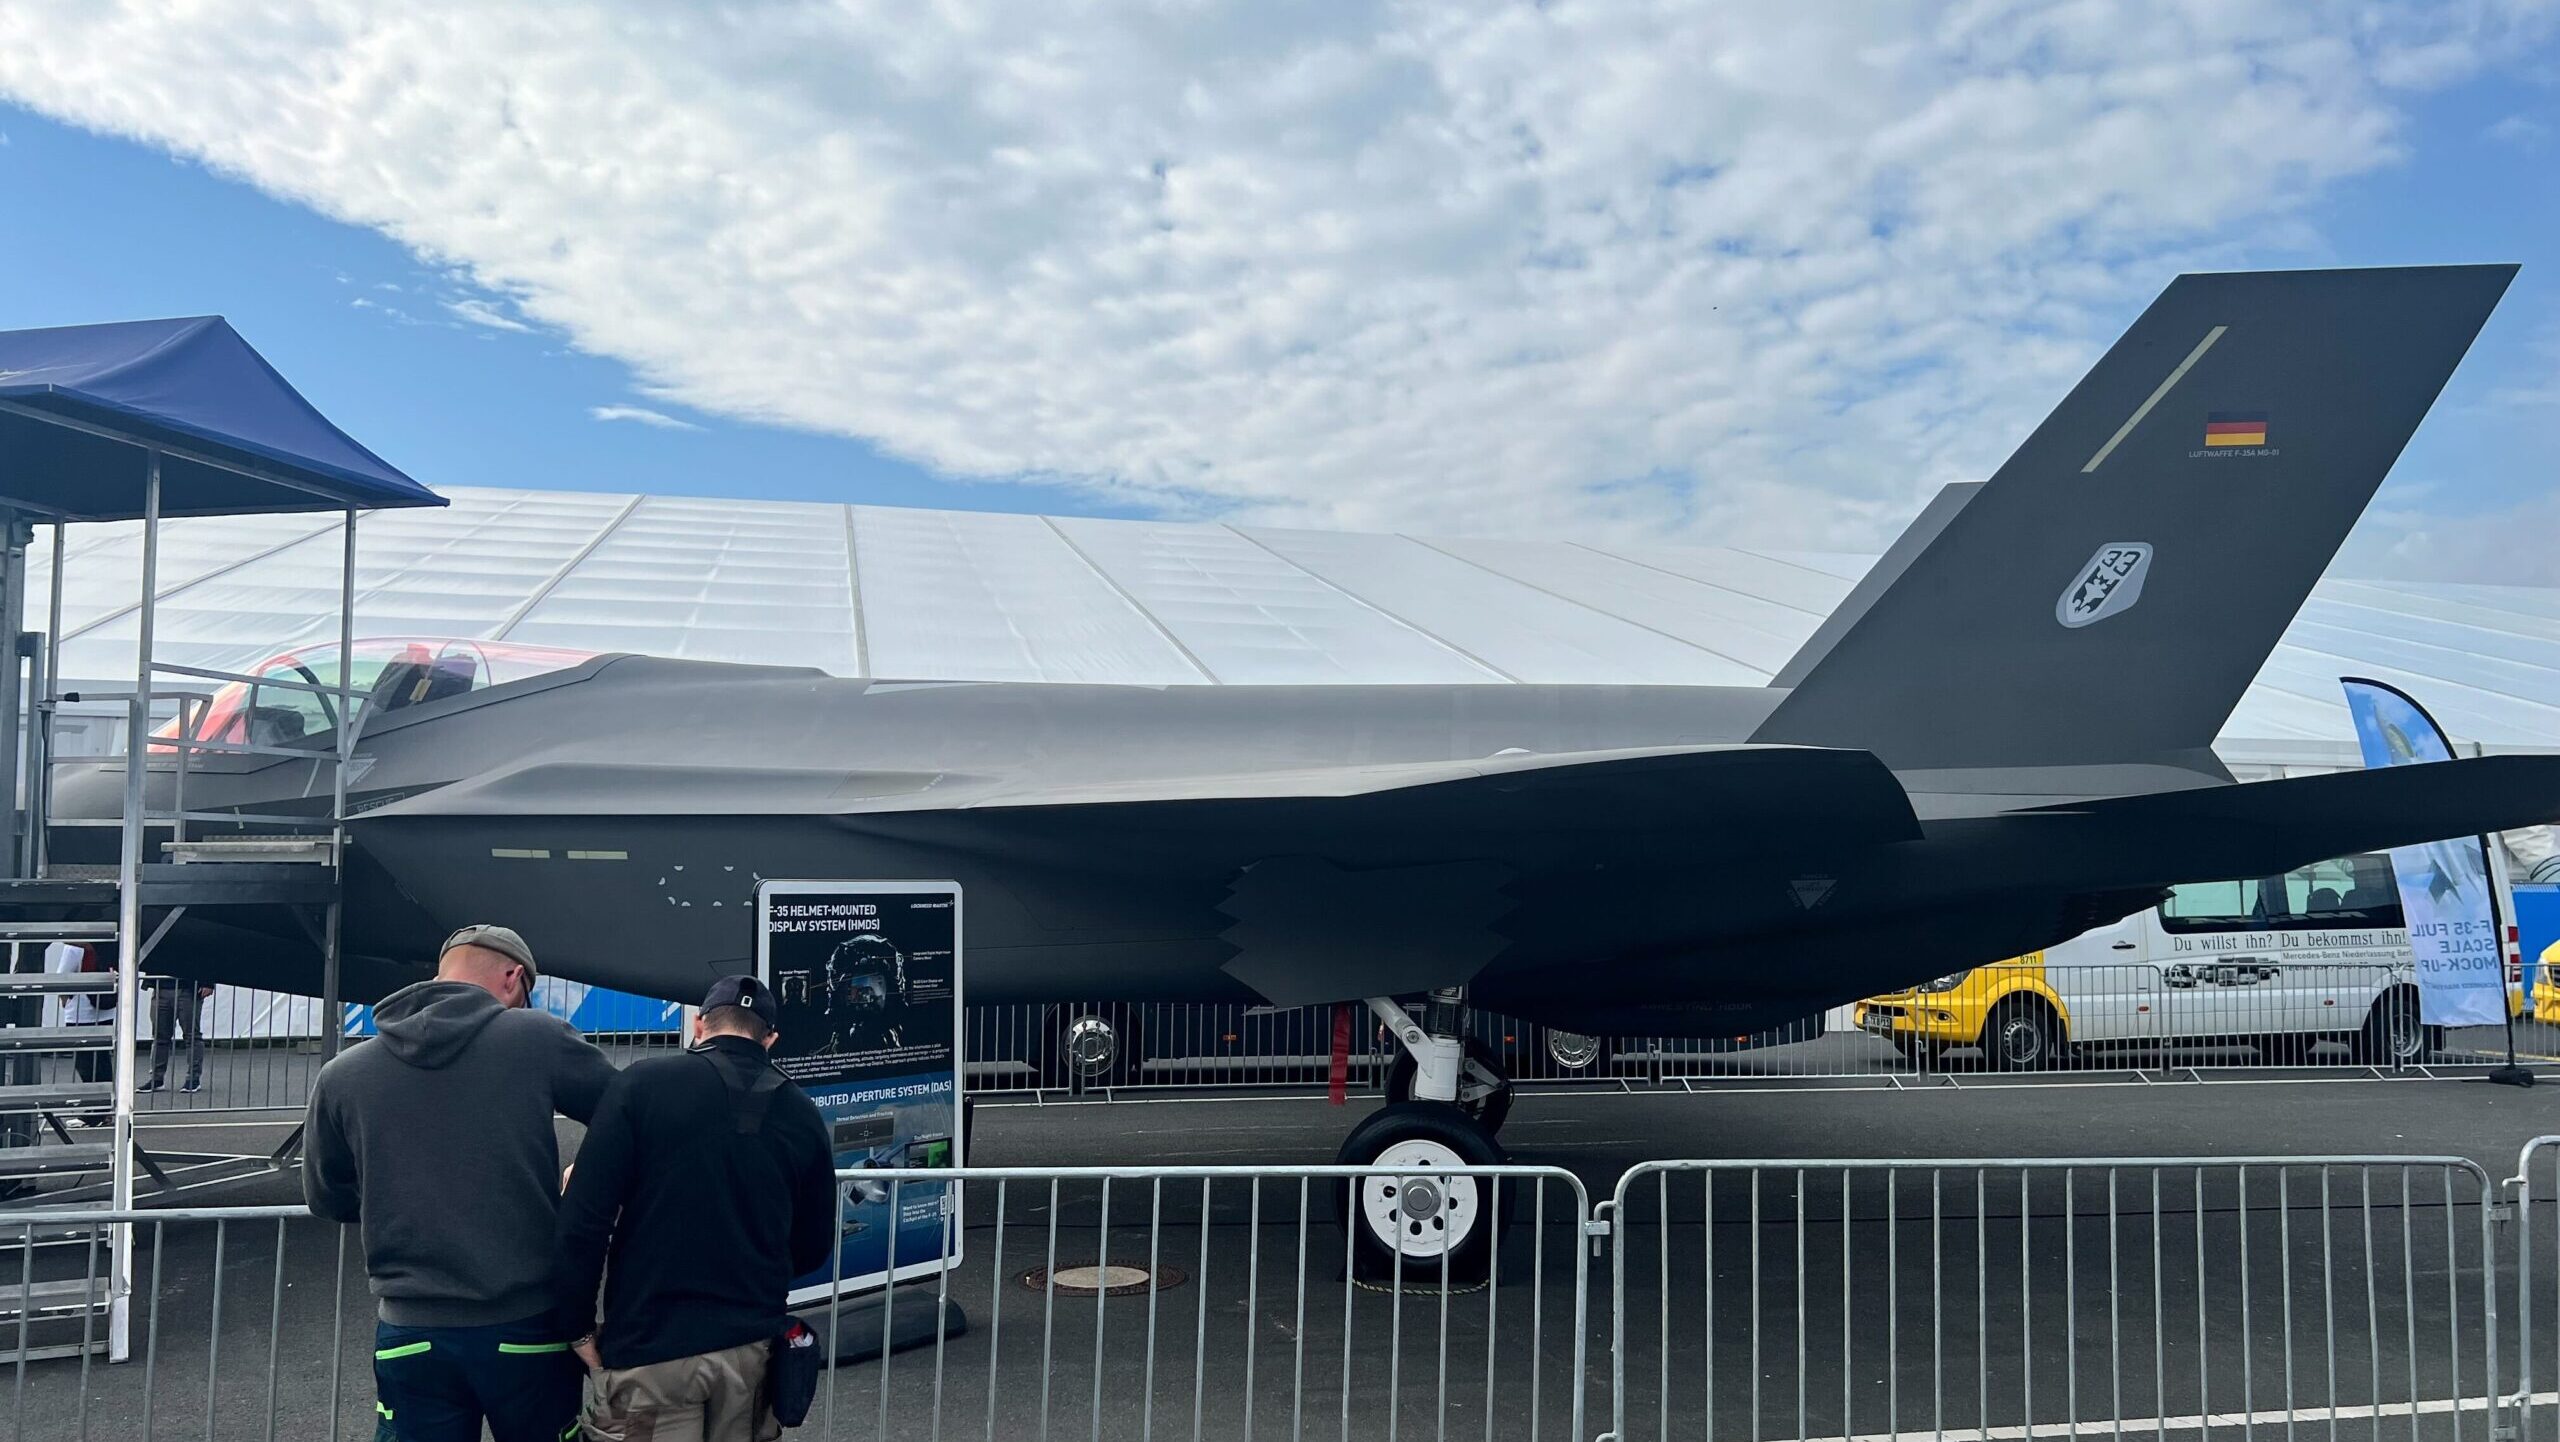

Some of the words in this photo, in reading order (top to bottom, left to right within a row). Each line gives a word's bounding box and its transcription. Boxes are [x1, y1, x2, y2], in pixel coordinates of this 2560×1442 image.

[2188, 449, 2233, 458] LUFTWAFFE
[2234, 449, 2255, 457] F-35A
[2101, 550, 2141, 577] 33
[357, 797, 394, 812] RESCU
[790, 904, 877, 917] HELMET-MOUNTED
[769, 920, 808, 933] DISPLAY
[809, 919, 847, 931] SYSTEM
[848, 917, 880, 932] (HMDS)
[2173, 936, 2192, 952] Du
[2201, 935, 2238, 950] willst
[2245, 933, 2273, 949] ihn?
[2281, 932, 2299, 947] Du
[2307, 931, 2374, 946] bekommst
[2381, 930, 2407, 945] ihn!
[2019, 955, 2037, 965] 8711
[2282, 951, 2341, 960] Mercedes-Benz
[2341, 950, 2396, 960] Niederlassung
[850, 1087, 897, 1104] APERTURE
[897, 1083, 930, 1098] SYSTEM
[930, 1079, 952, 1094] (DAS)
